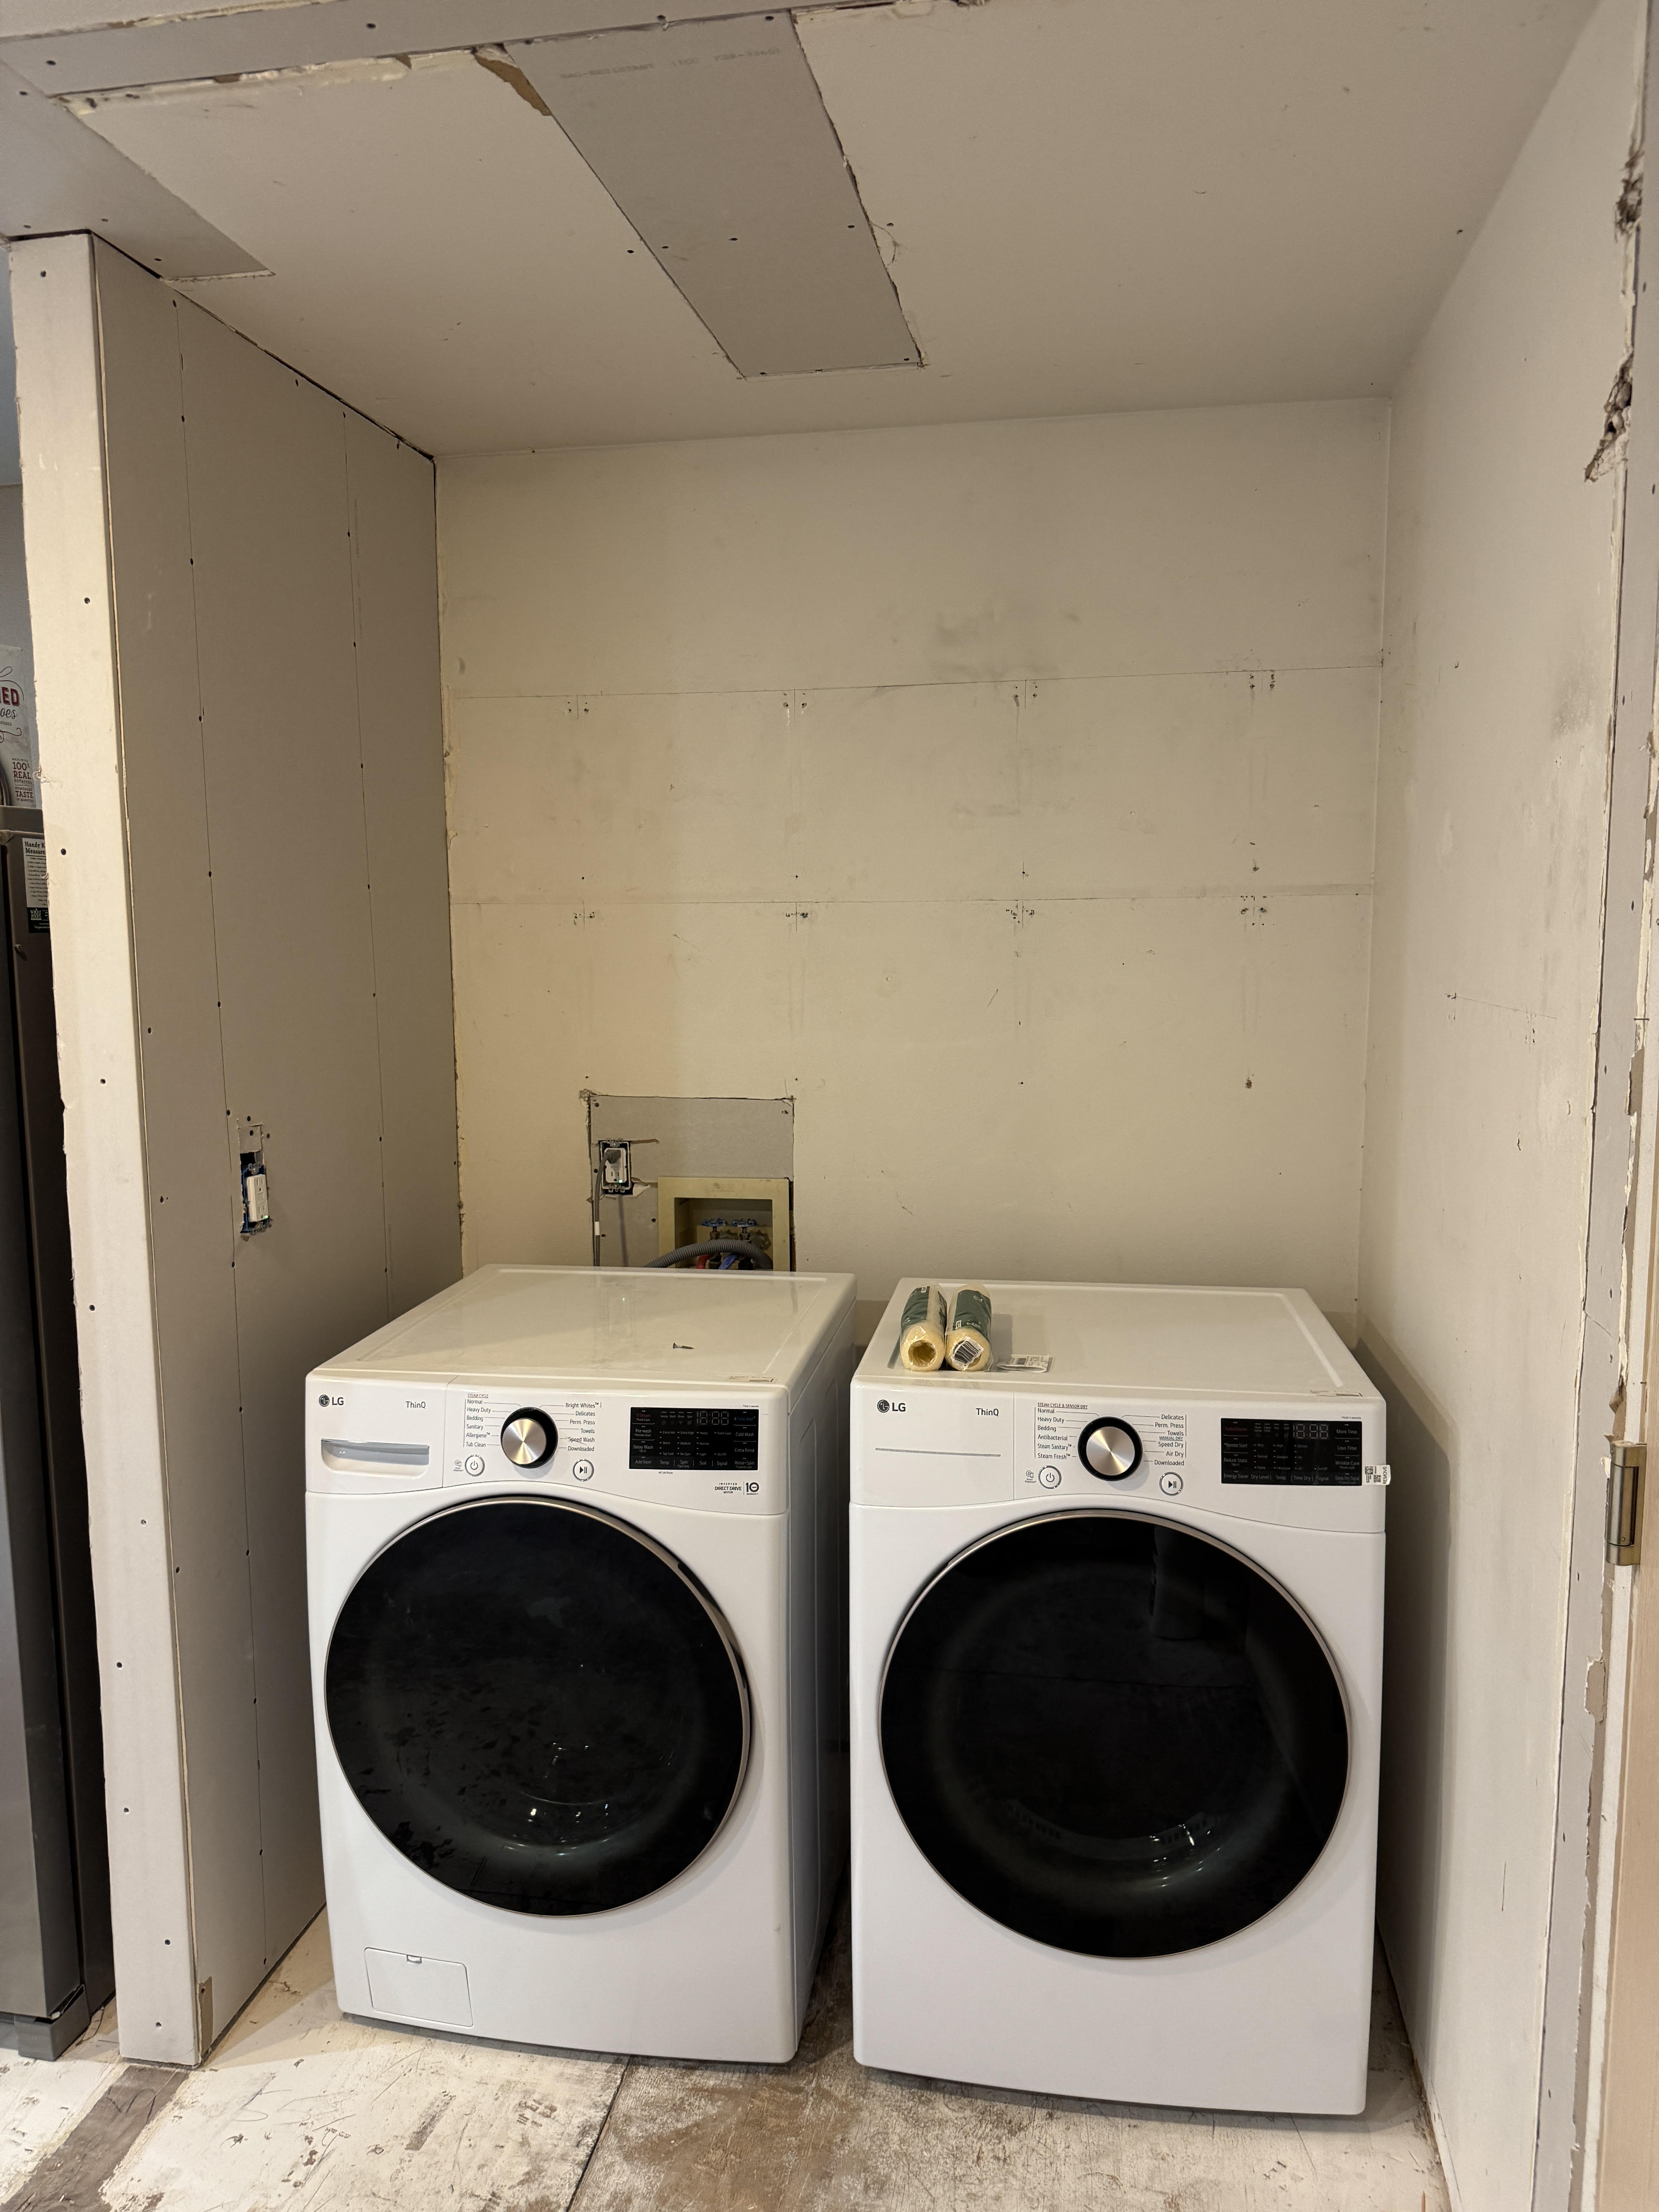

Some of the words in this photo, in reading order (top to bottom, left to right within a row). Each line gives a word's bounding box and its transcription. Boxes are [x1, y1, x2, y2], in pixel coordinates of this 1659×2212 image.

[0, 687, 20, 706] ED
[13, 771, 31, 780] REAL
[332, 1396, 344, 1406] LG
[405, 1401, 426, 1409] ThinQ
[892, 1403, 906, 1412] LG
[975, 1408, 999, 1417] ThinQ
